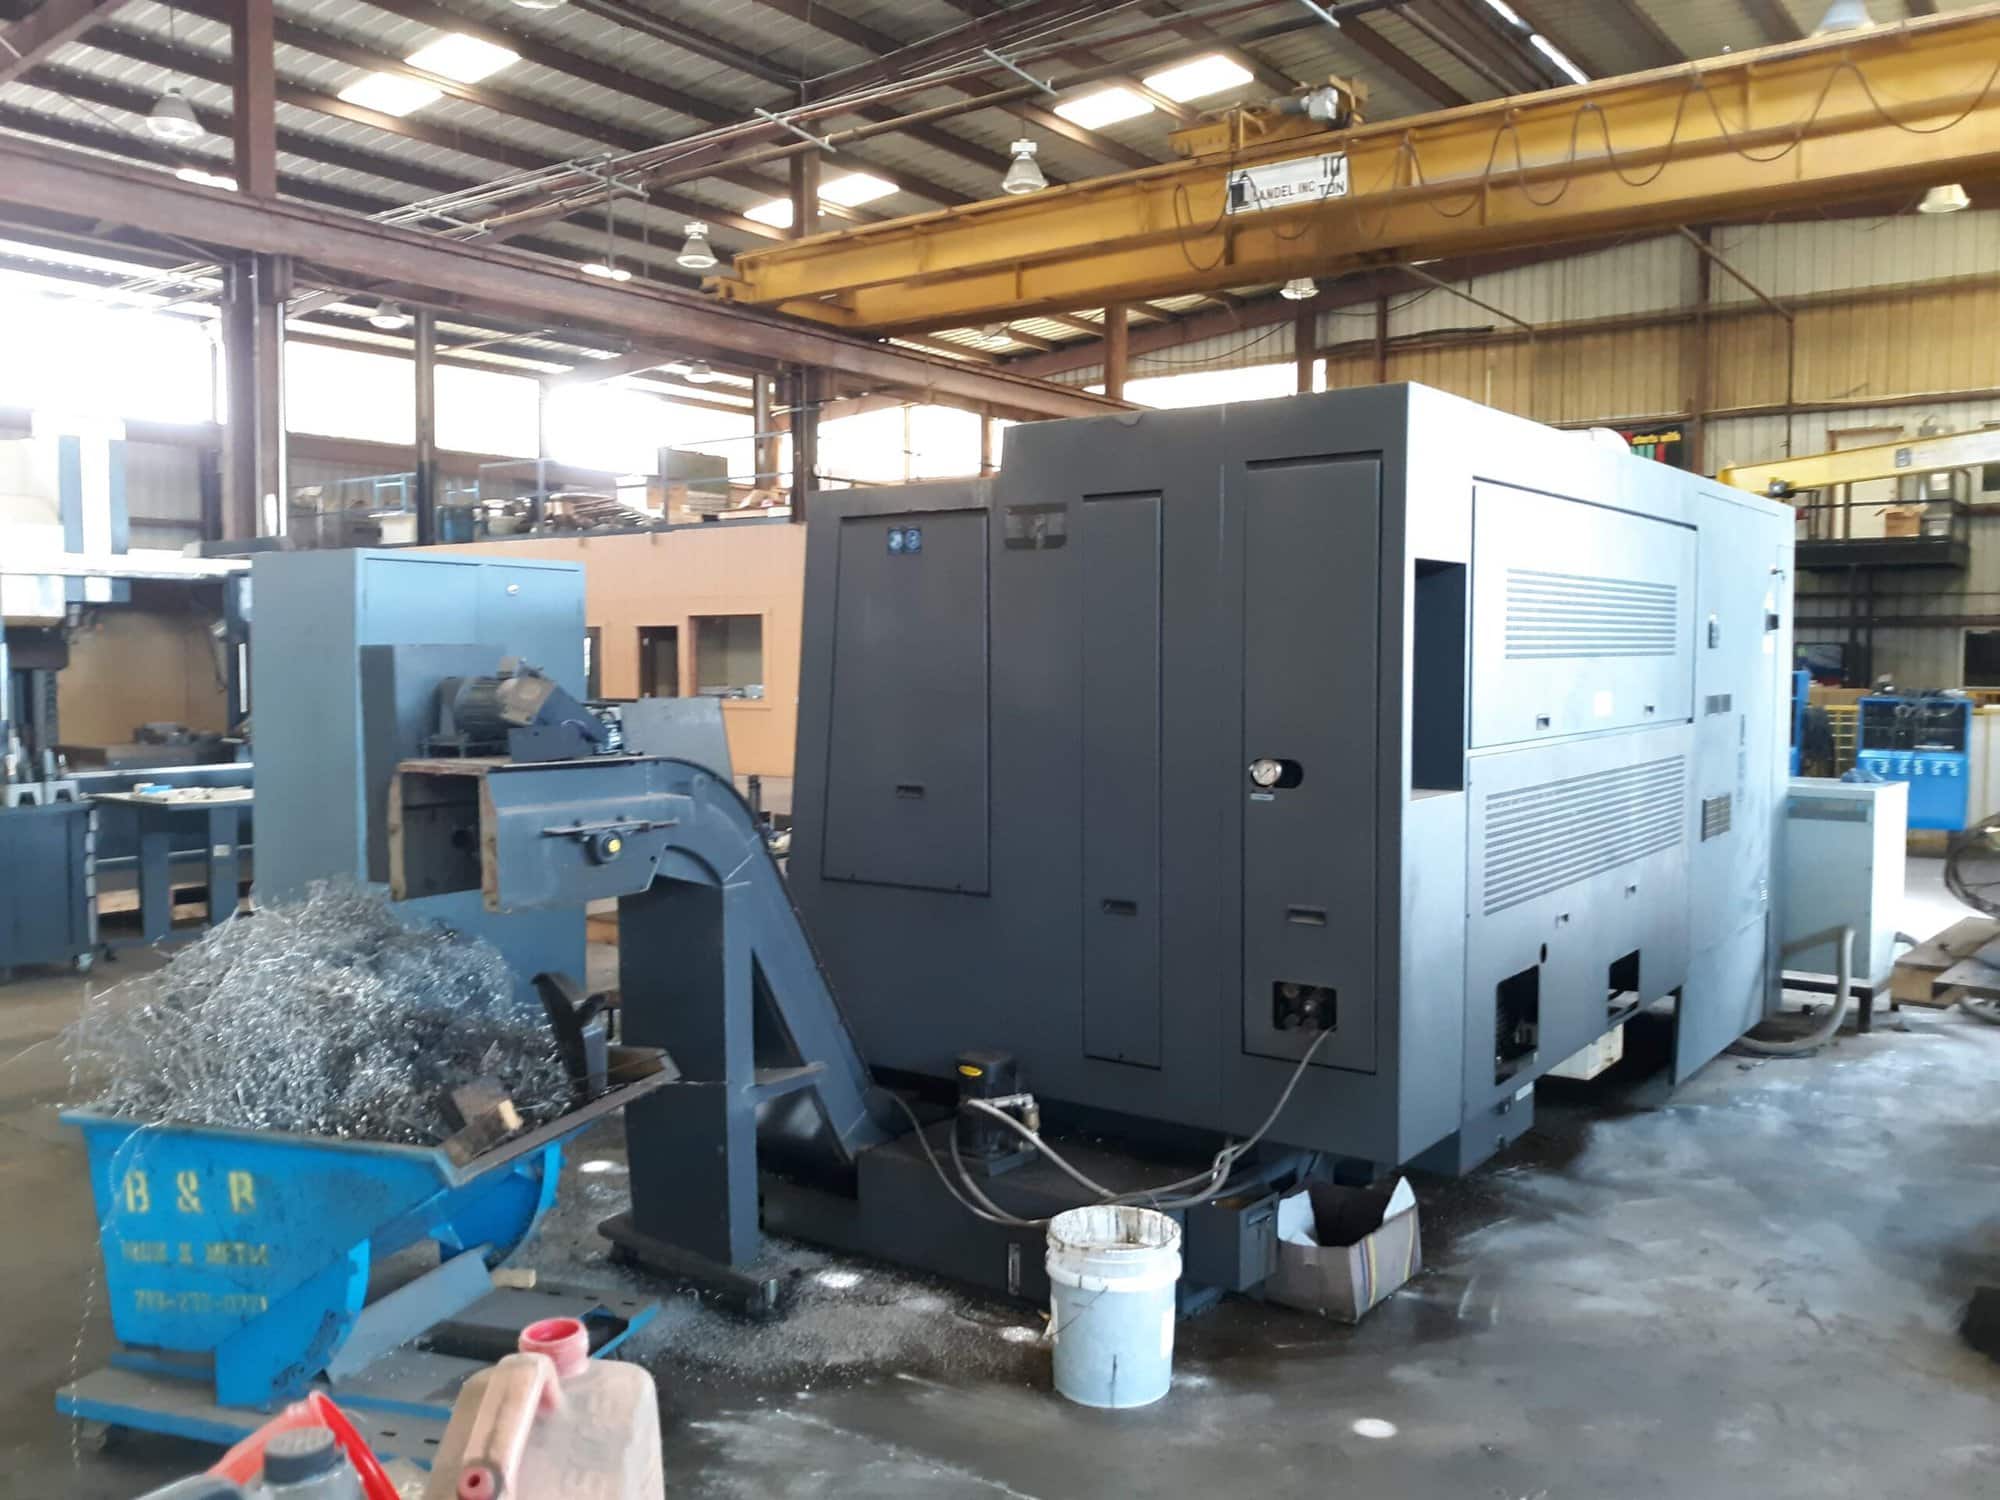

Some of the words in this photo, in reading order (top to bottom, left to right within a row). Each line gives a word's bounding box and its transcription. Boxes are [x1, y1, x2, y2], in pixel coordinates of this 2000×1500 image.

[1322, 156, 1341, 177] 10
[1298, 181, 1315, 193] INC
[1319, 180, 1345, 196] TON
[125, 1170, 150, 1213] B
[176, 1170, 203, 1214] &
[228, 1170, 256, 1213] R
